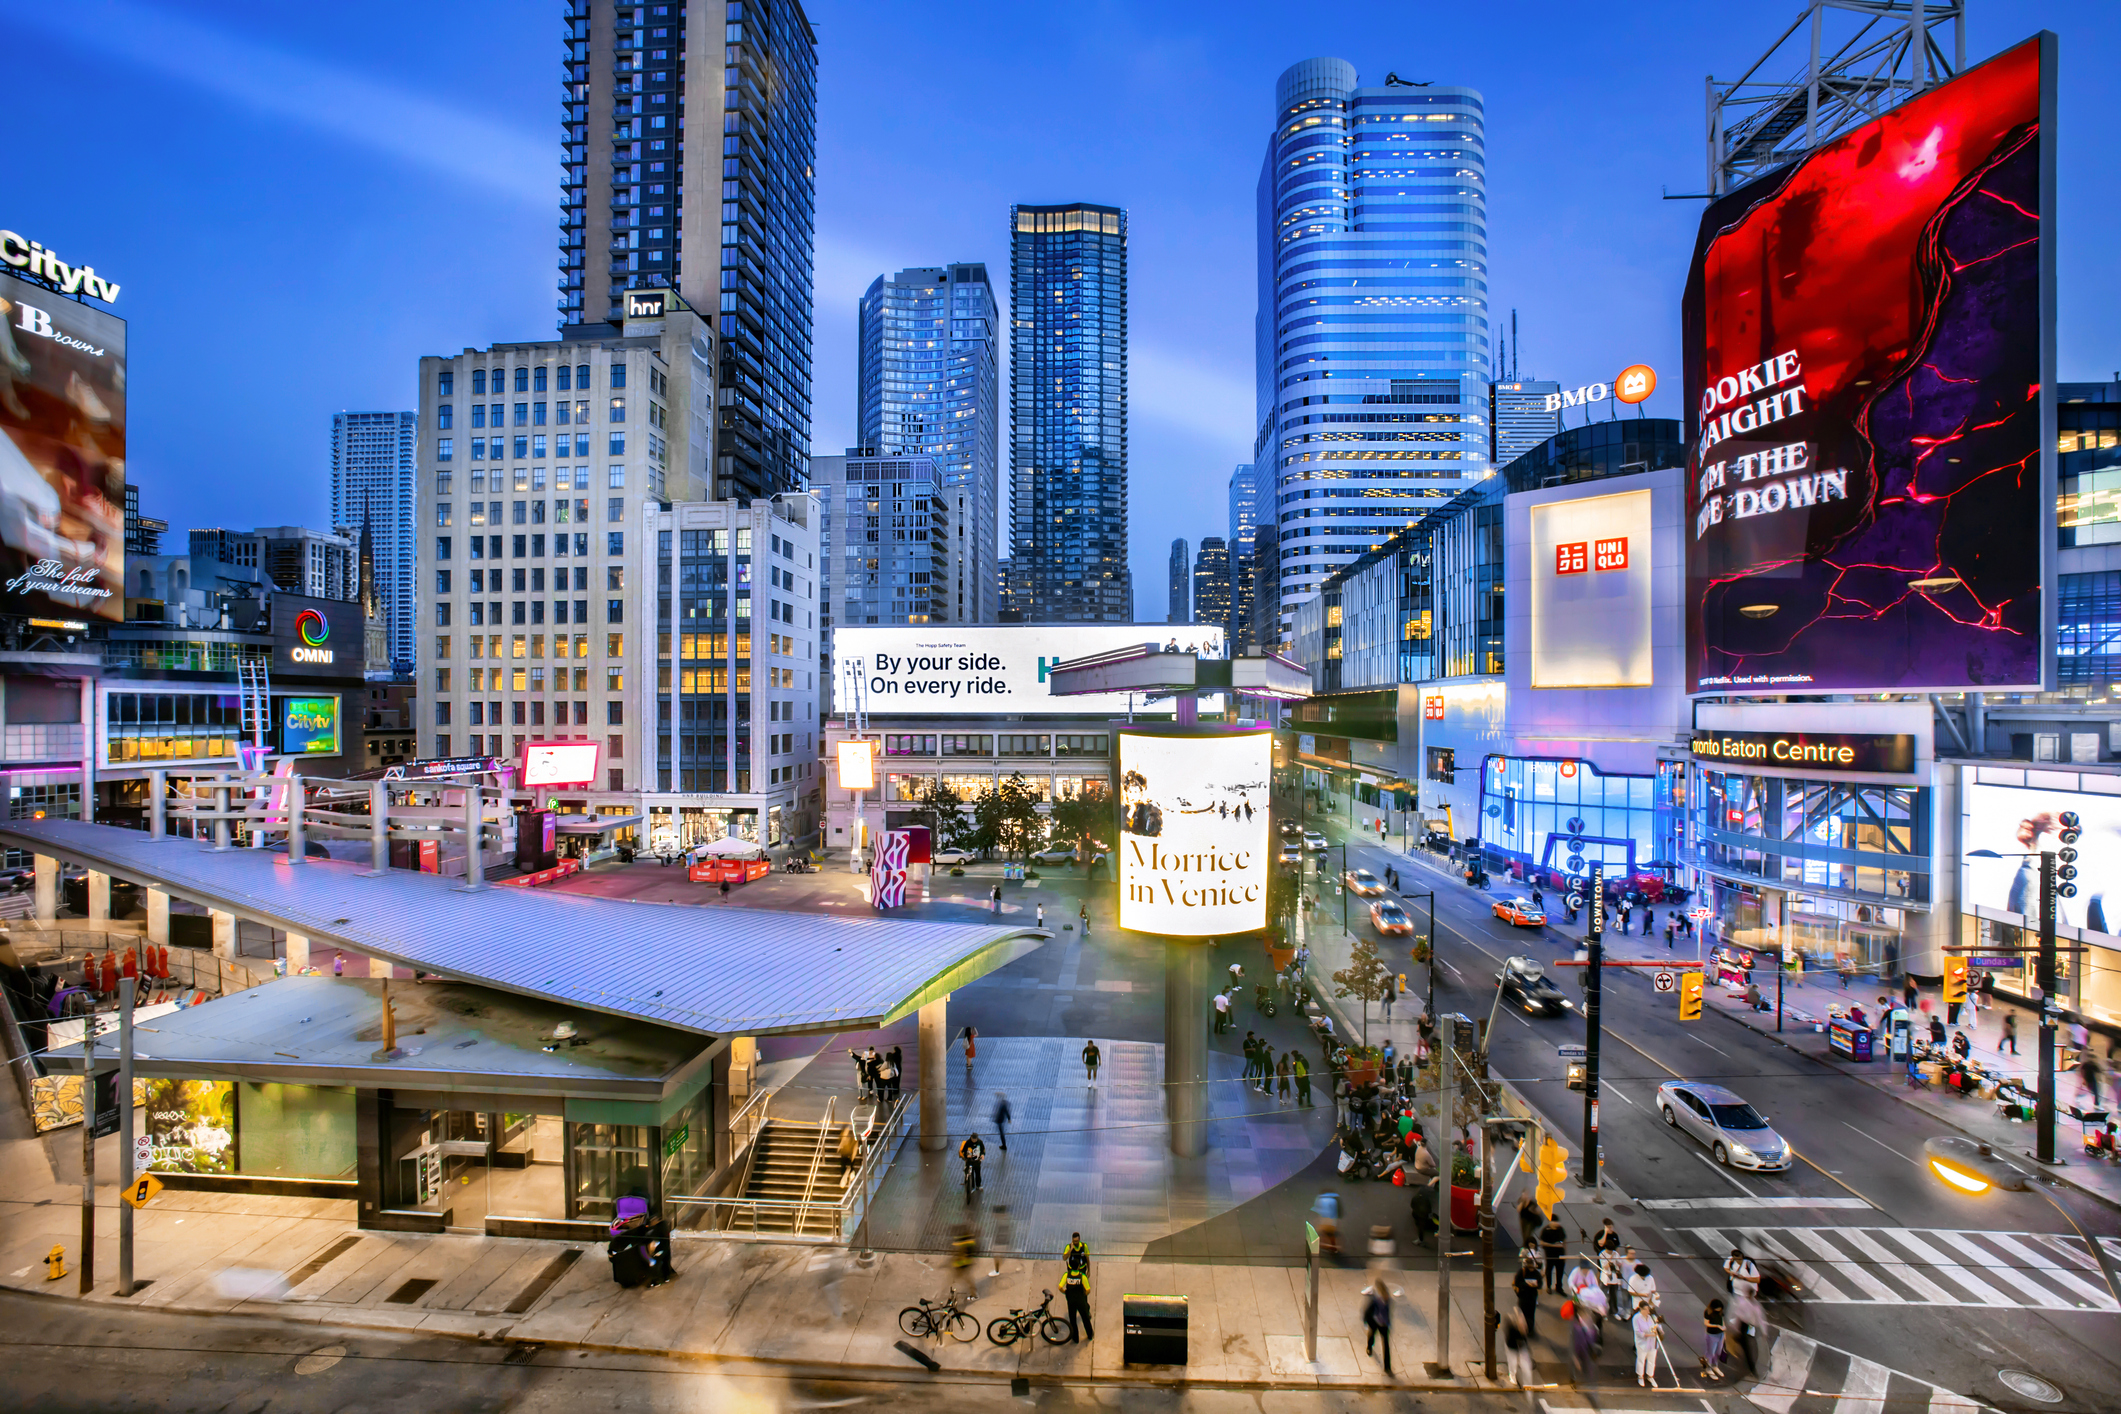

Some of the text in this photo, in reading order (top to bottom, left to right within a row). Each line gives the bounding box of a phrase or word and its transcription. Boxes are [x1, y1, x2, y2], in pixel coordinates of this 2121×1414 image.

[0, 229, 121, 304] Citytv
[630, 296, 661, 315] hnr
[15, 300, 104, 357] Browns
[1544, 382, 1608, 412] BMO
[1738, 441, 1809, 482] THE
[1735, 466, 1848, 519] DOWN
[1597, 541, 1622, 554] UNI
[30, 558, 101, 585] The fall
[1597, 553, 1625, 568] QLO
[6, 572, 113, 598] of your dreams
[292, 647, 333, 663] OMNI
[876, 652, 1006, 675] By your side.
[870, 676, 1012, 698] On every ride.
[1733, 675, 1752, 684] Used
[1753, 674, 1769, 683] with
[1770, 674, 1813, 685] permission.
[286, 713, 330, 731] Citytv
[1722, 738, 1767, 759] Eaton
[1773, 739, 1855, 763] Centre
[424, 762, 481, 774] sankofa square
[1129, 840, 1250, 872] Morrice
[1129, 875, 1259, 907] in Venice
[1594, 867, 1602, 933] DOWNTOWN
[1975, 957, 2007, 966] Dundas
